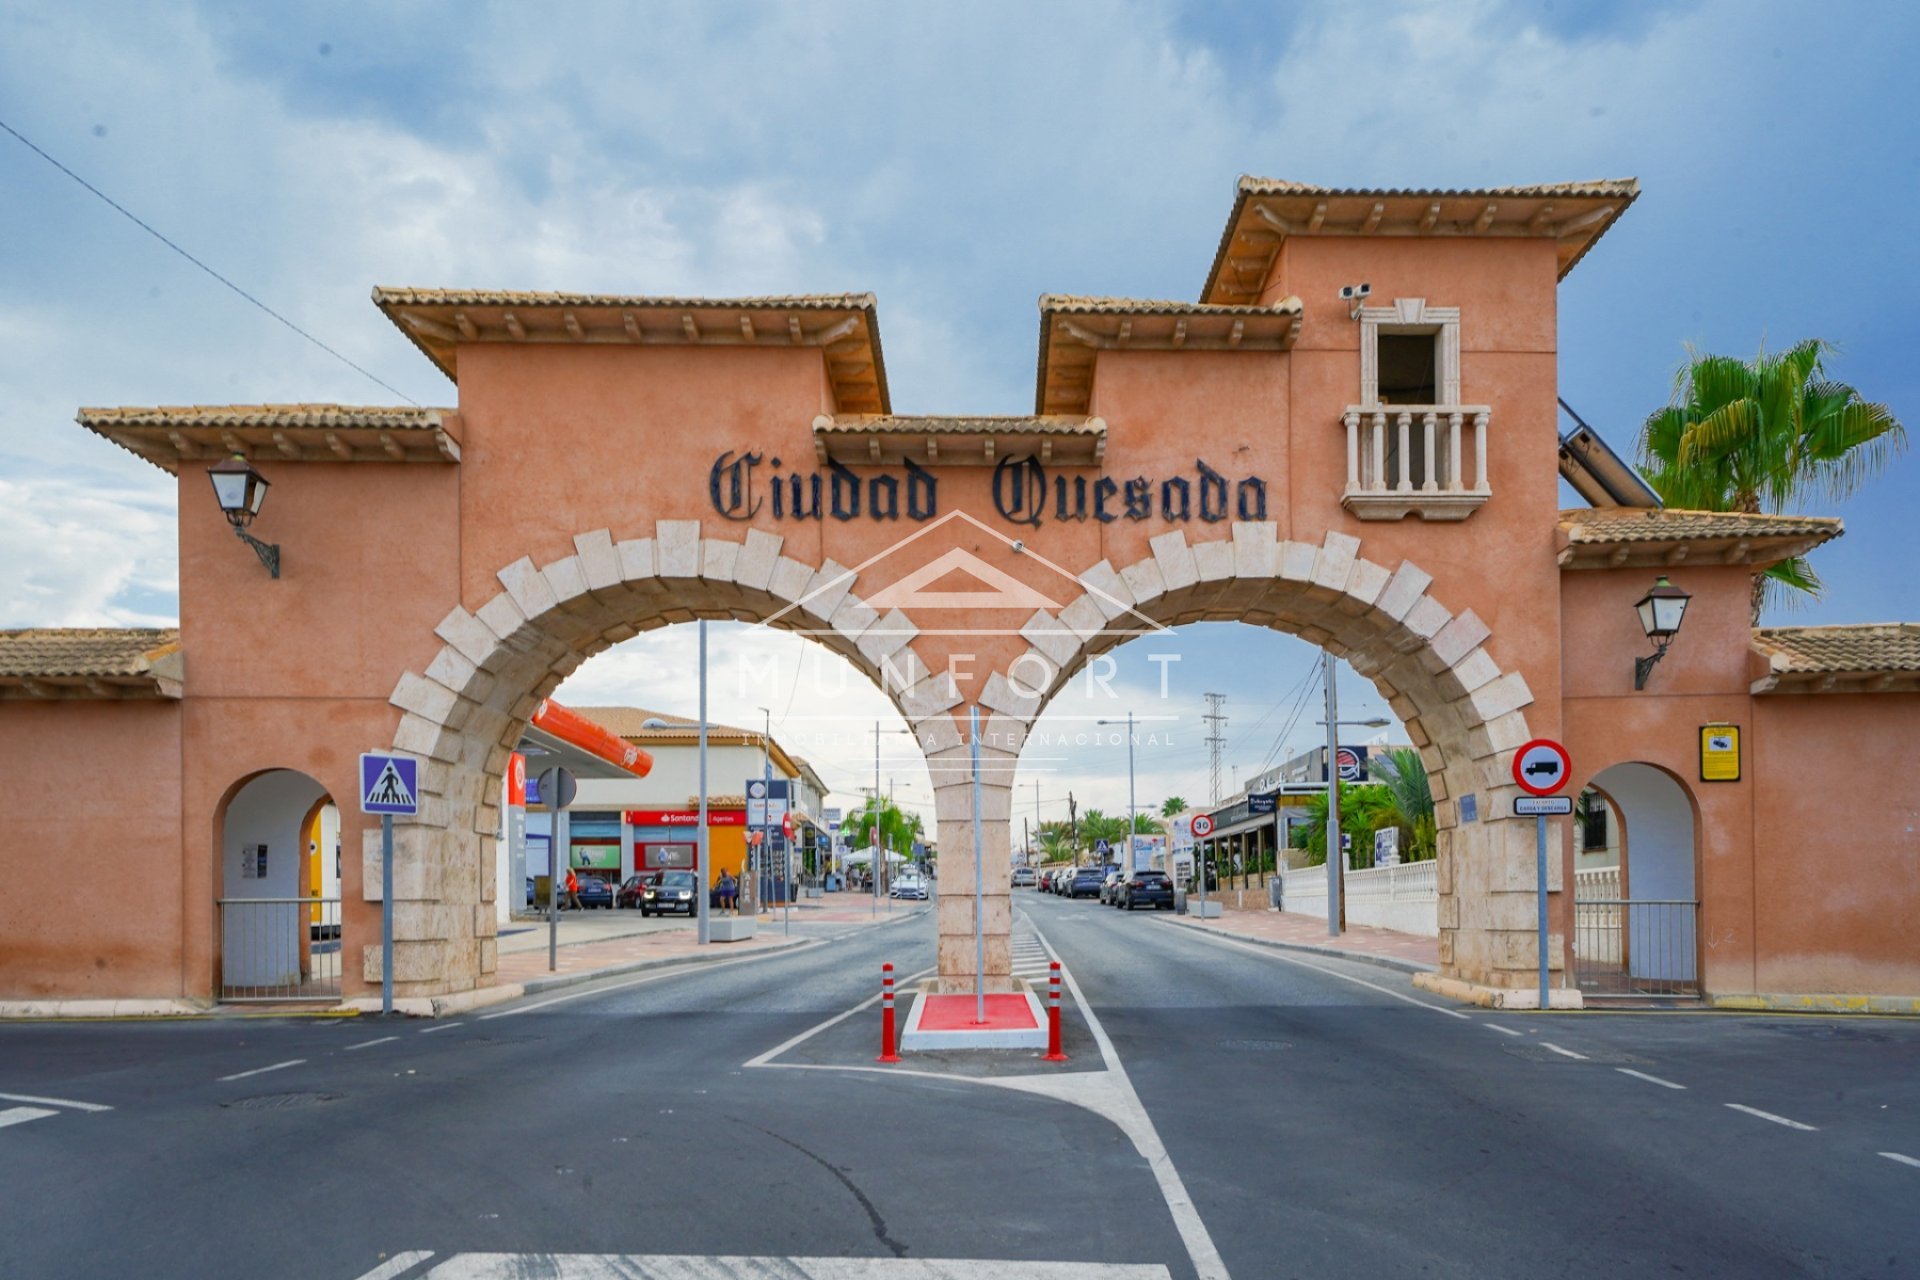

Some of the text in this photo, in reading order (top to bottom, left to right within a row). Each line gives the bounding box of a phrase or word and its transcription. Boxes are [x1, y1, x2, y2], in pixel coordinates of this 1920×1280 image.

[710, 451, 1267, 530] Ciudad Quesada
[670, 813, 700, 823] Santand
[1196, 821, 1209, 830] 30
